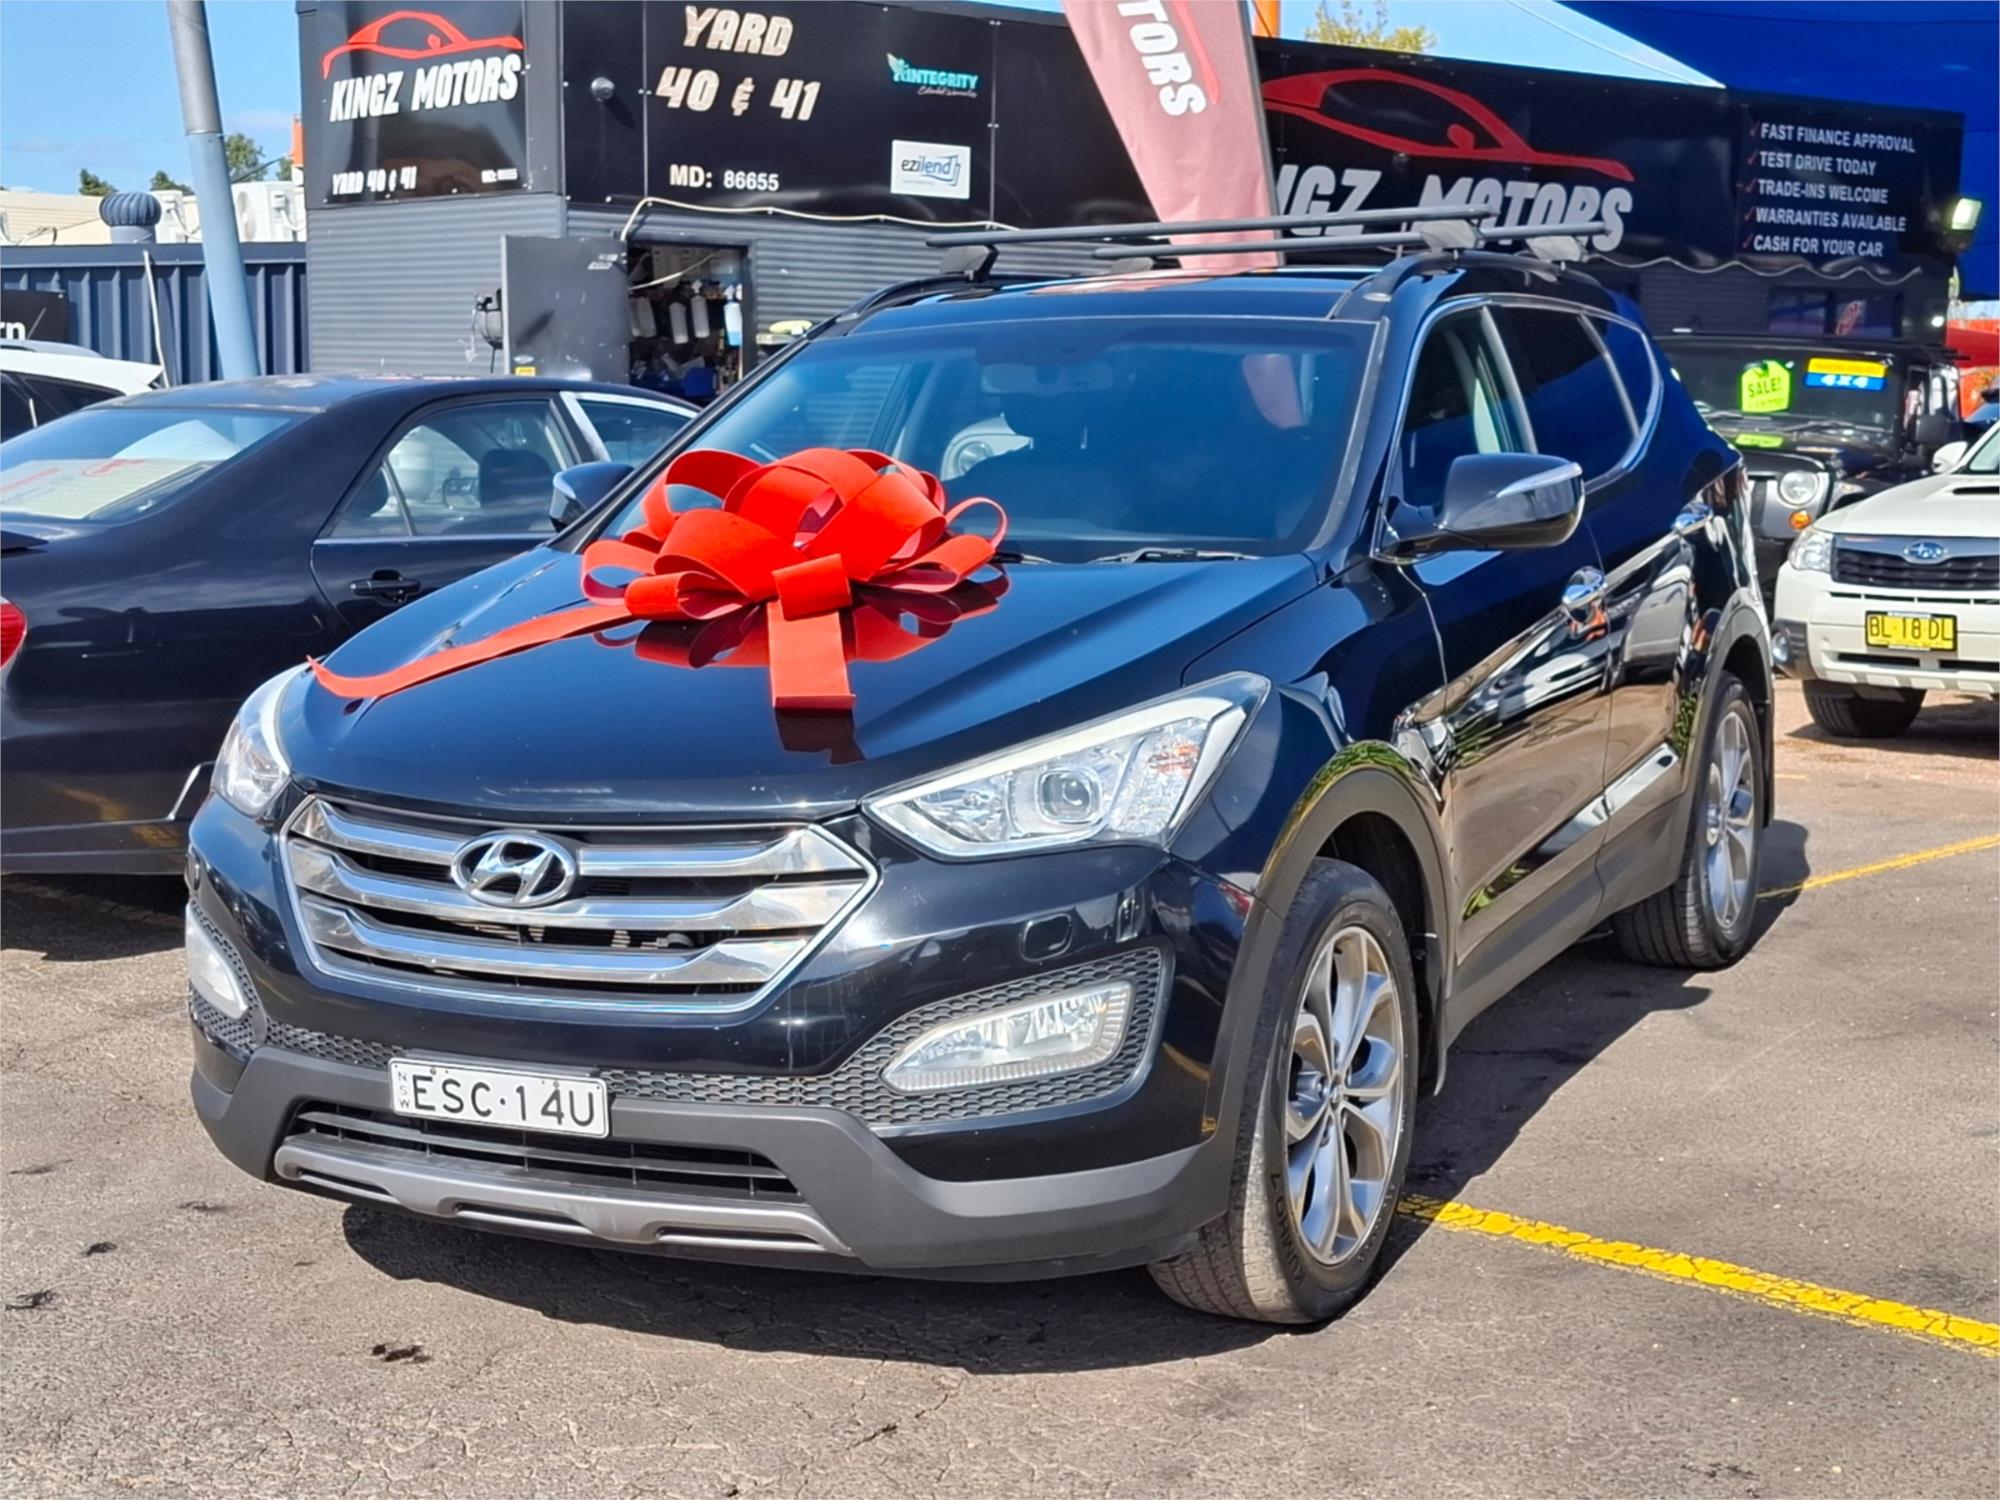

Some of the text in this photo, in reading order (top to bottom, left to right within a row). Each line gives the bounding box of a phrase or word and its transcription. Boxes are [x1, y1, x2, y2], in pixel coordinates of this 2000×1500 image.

[683, 5, 793, 57] YARD
[330, 54, 521, 122] KINGZ MOTORS
[655, 66, 821, 121] 40 & 41
[1760, 122, 1916, 153] FAST FINANCE APPROVAL
[1760, 151, 1877, 176] TEST DRIVE TODAY
[669, 164, 779, 192] MD: 86655
[1758, 179, 1889, 204] TRADE-INS WELCOME
[1756, 206, 1907, 233] WARRANTIES AVAILABLE
[1753, 234, 1883, 257] CASH FOR YOUR CAR
[1748, 377, 1781, 398] SALE!
